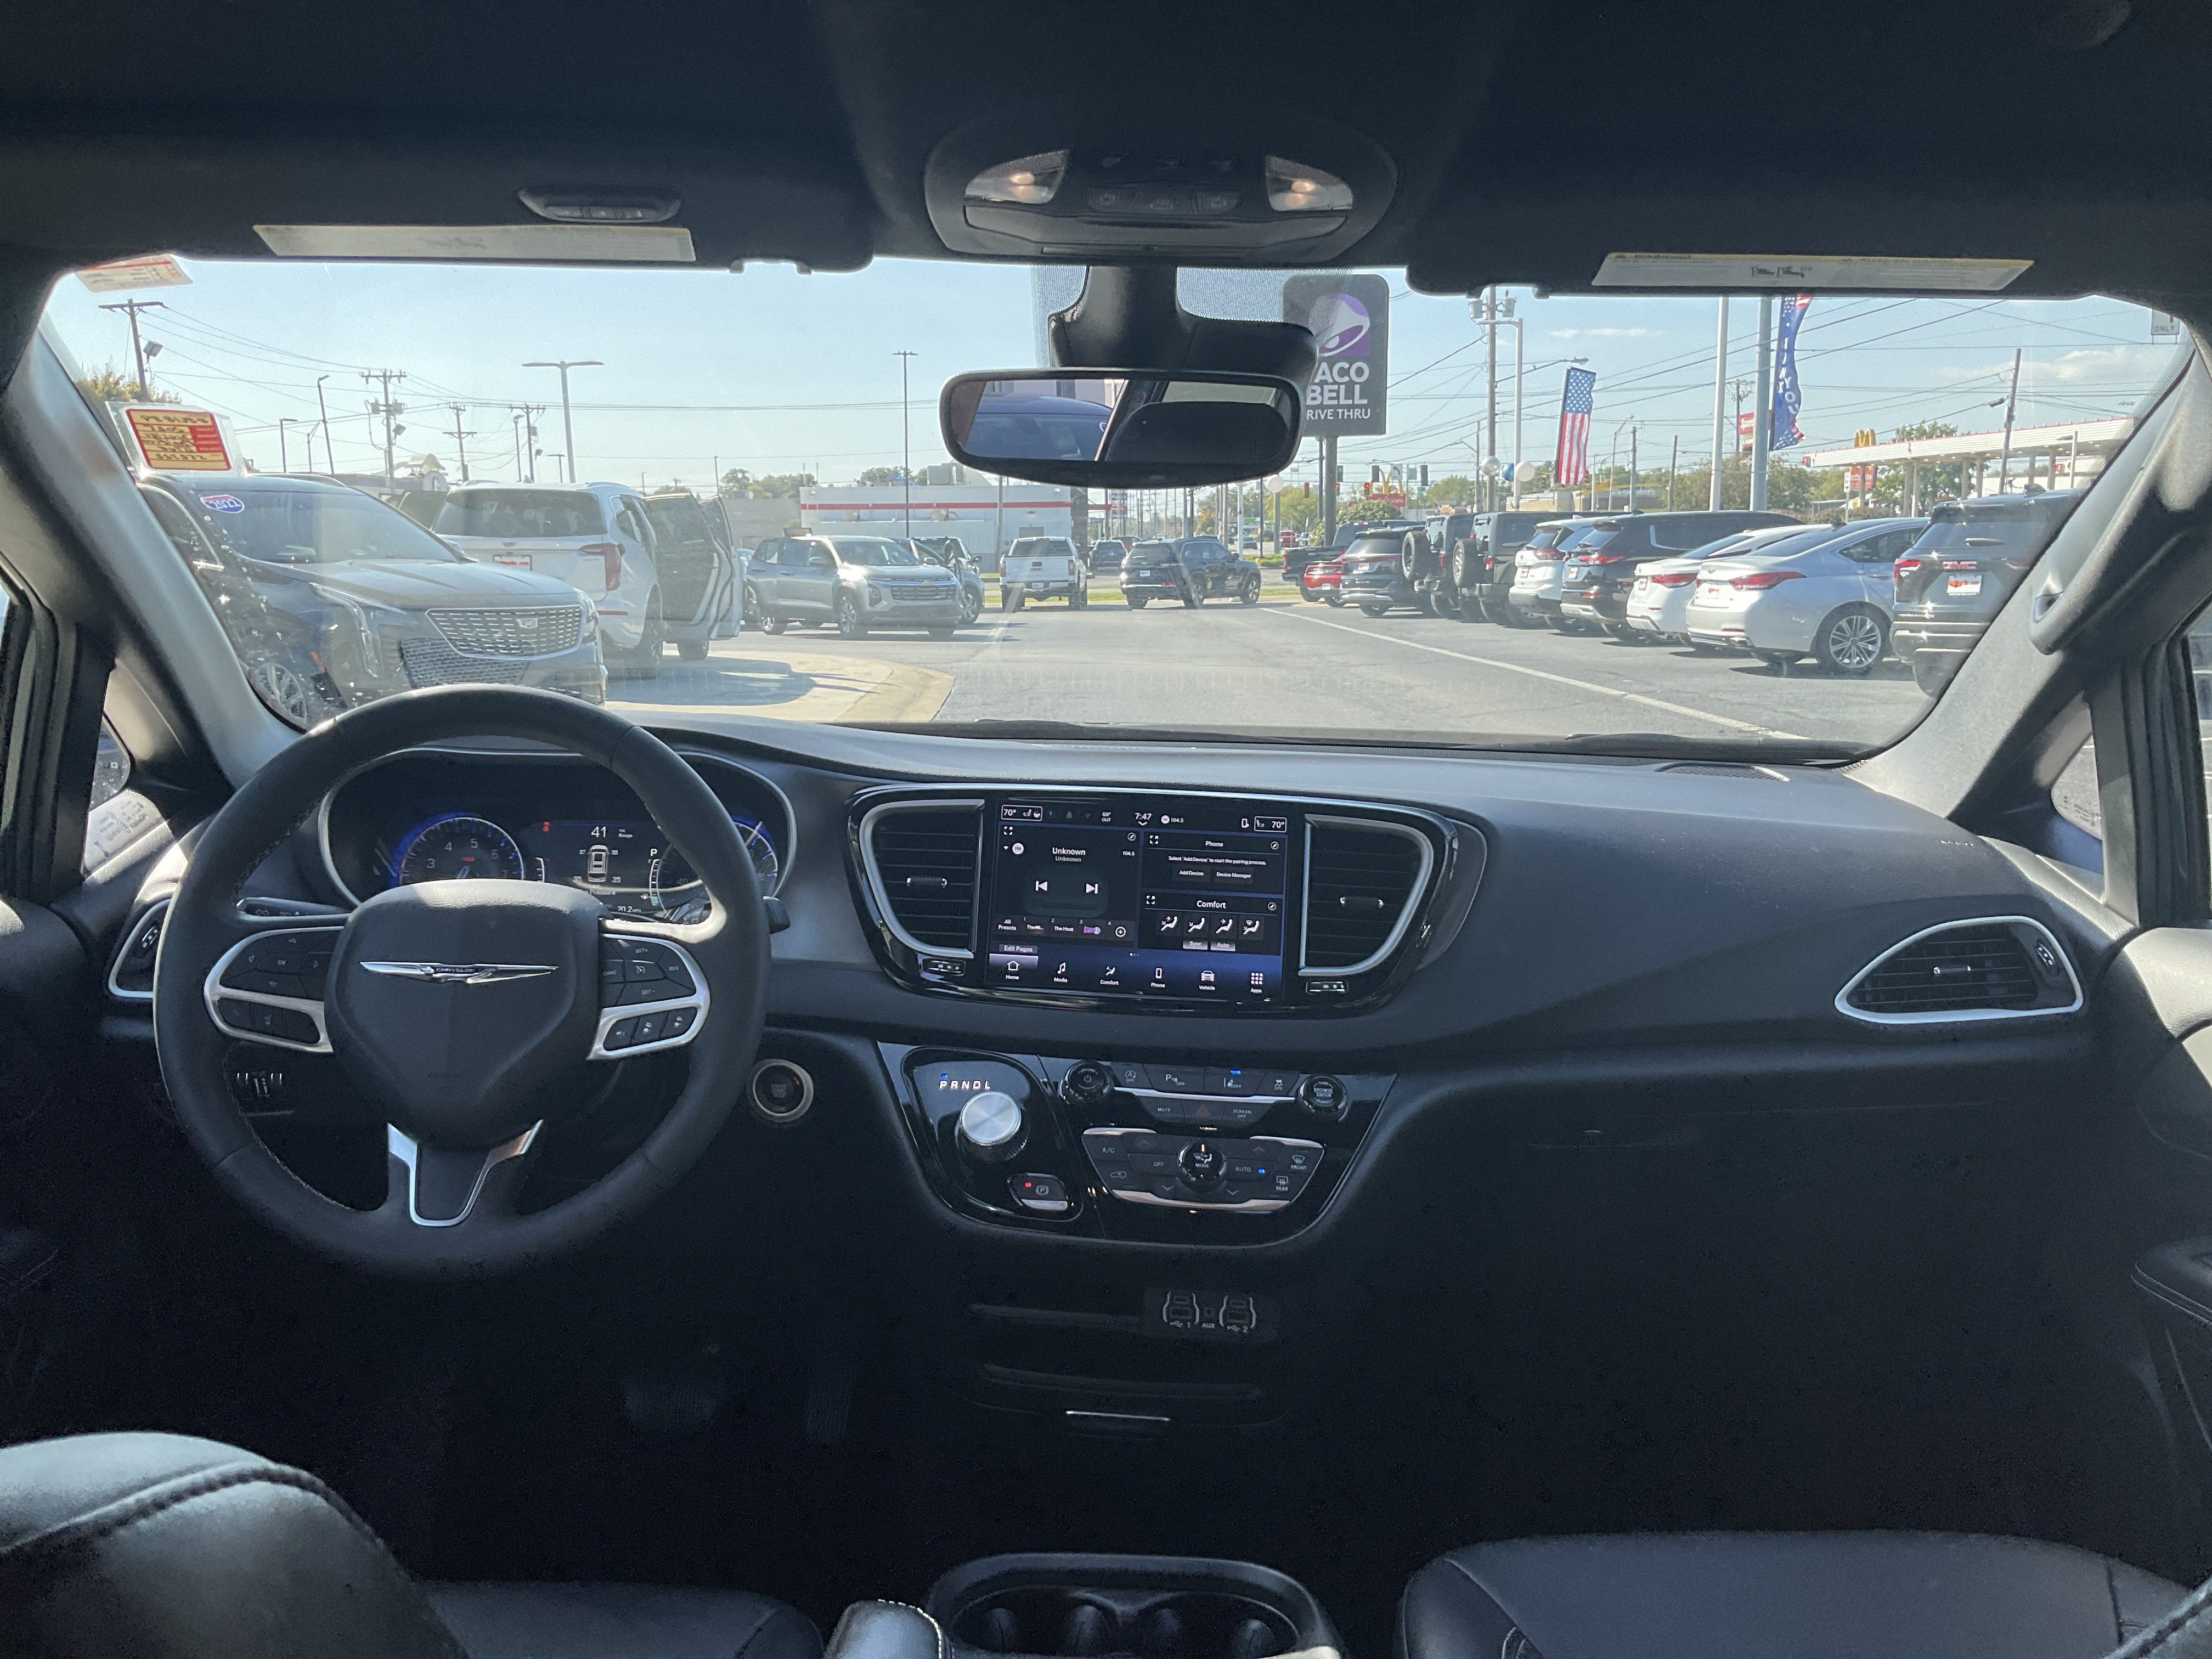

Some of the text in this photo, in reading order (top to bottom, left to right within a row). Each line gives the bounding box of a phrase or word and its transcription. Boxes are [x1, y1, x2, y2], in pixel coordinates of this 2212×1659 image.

[1314, 362, 1369, 383] ACO
[1305, 384, 1368, 405] BELL
[1306, 408, 1371, 420] RIVE THRU
[209, 500, 241, 510] 2022
[1943, 561, 1977, 569] GMC
[591, 826, 607, 838] 41
[444, 842, 453, 852] 4
[470, 838, 478, 849] 5
[491, 849, 499, 860] 6
[650, 848, 658, 856] P
[1052, 847, 1086, 855] Unknown
[426, 858, 435, 868] 3
[1197, 900, 1226, 909] Comfort
